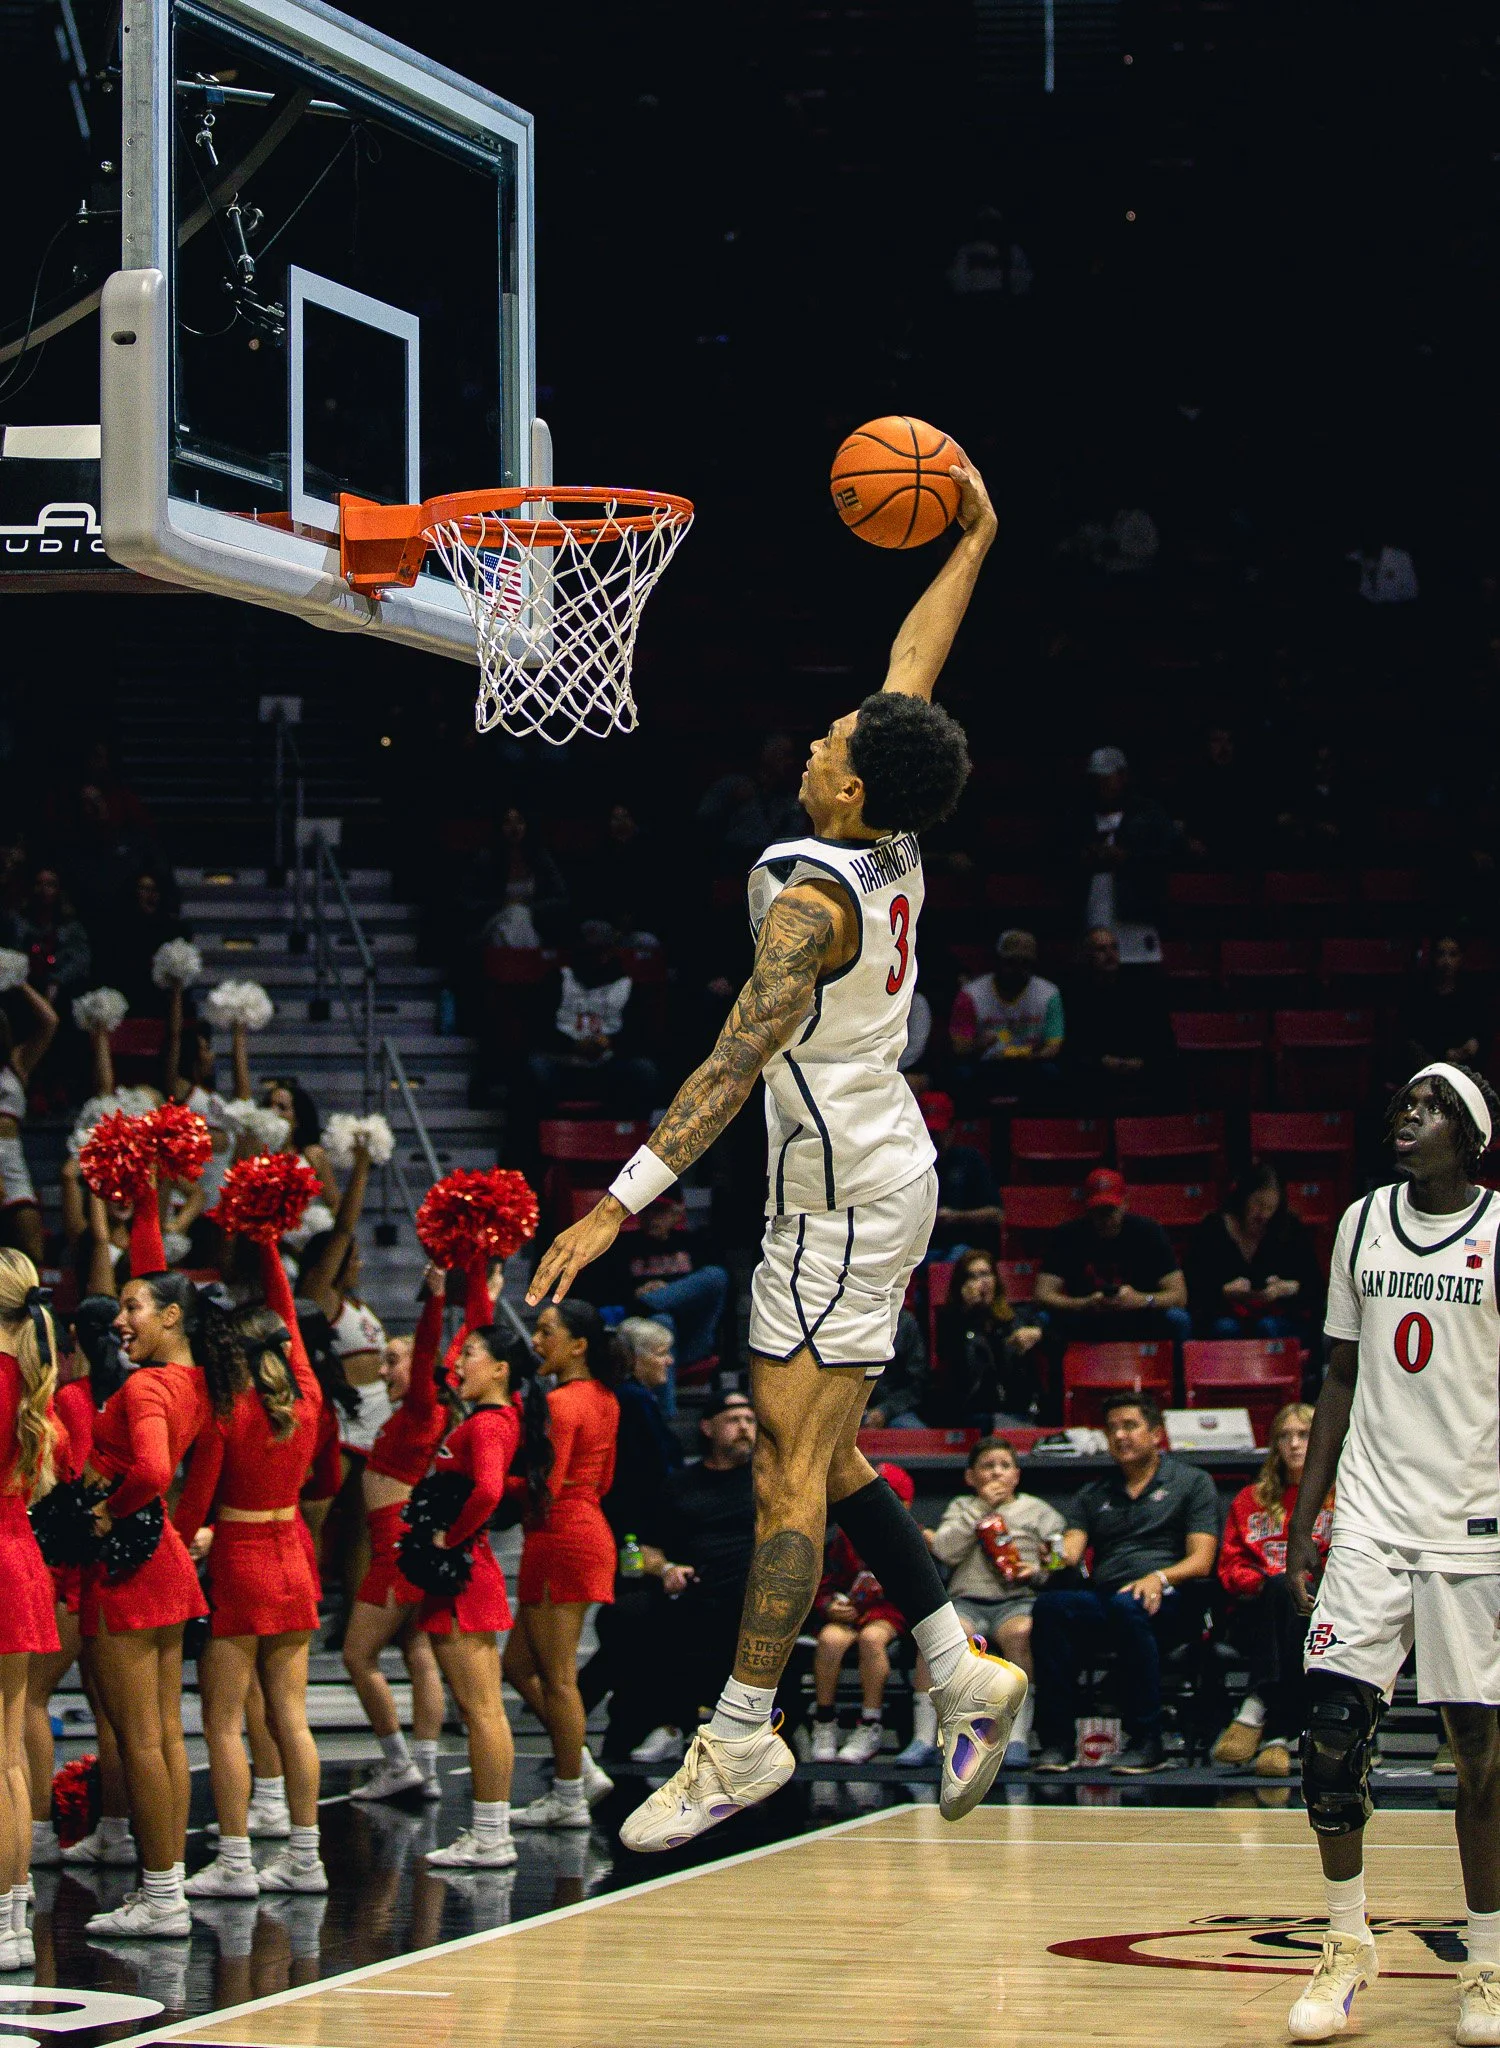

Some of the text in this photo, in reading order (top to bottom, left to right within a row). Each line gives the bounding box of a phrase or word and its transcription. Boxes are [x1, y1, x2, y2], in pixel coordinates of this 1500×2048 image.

[886, 894, 910, 996] 3
[1361, 1269, 1484, 1306] SAN DIEGO STATE
[1394, 1311, 1434, 1374] 0
